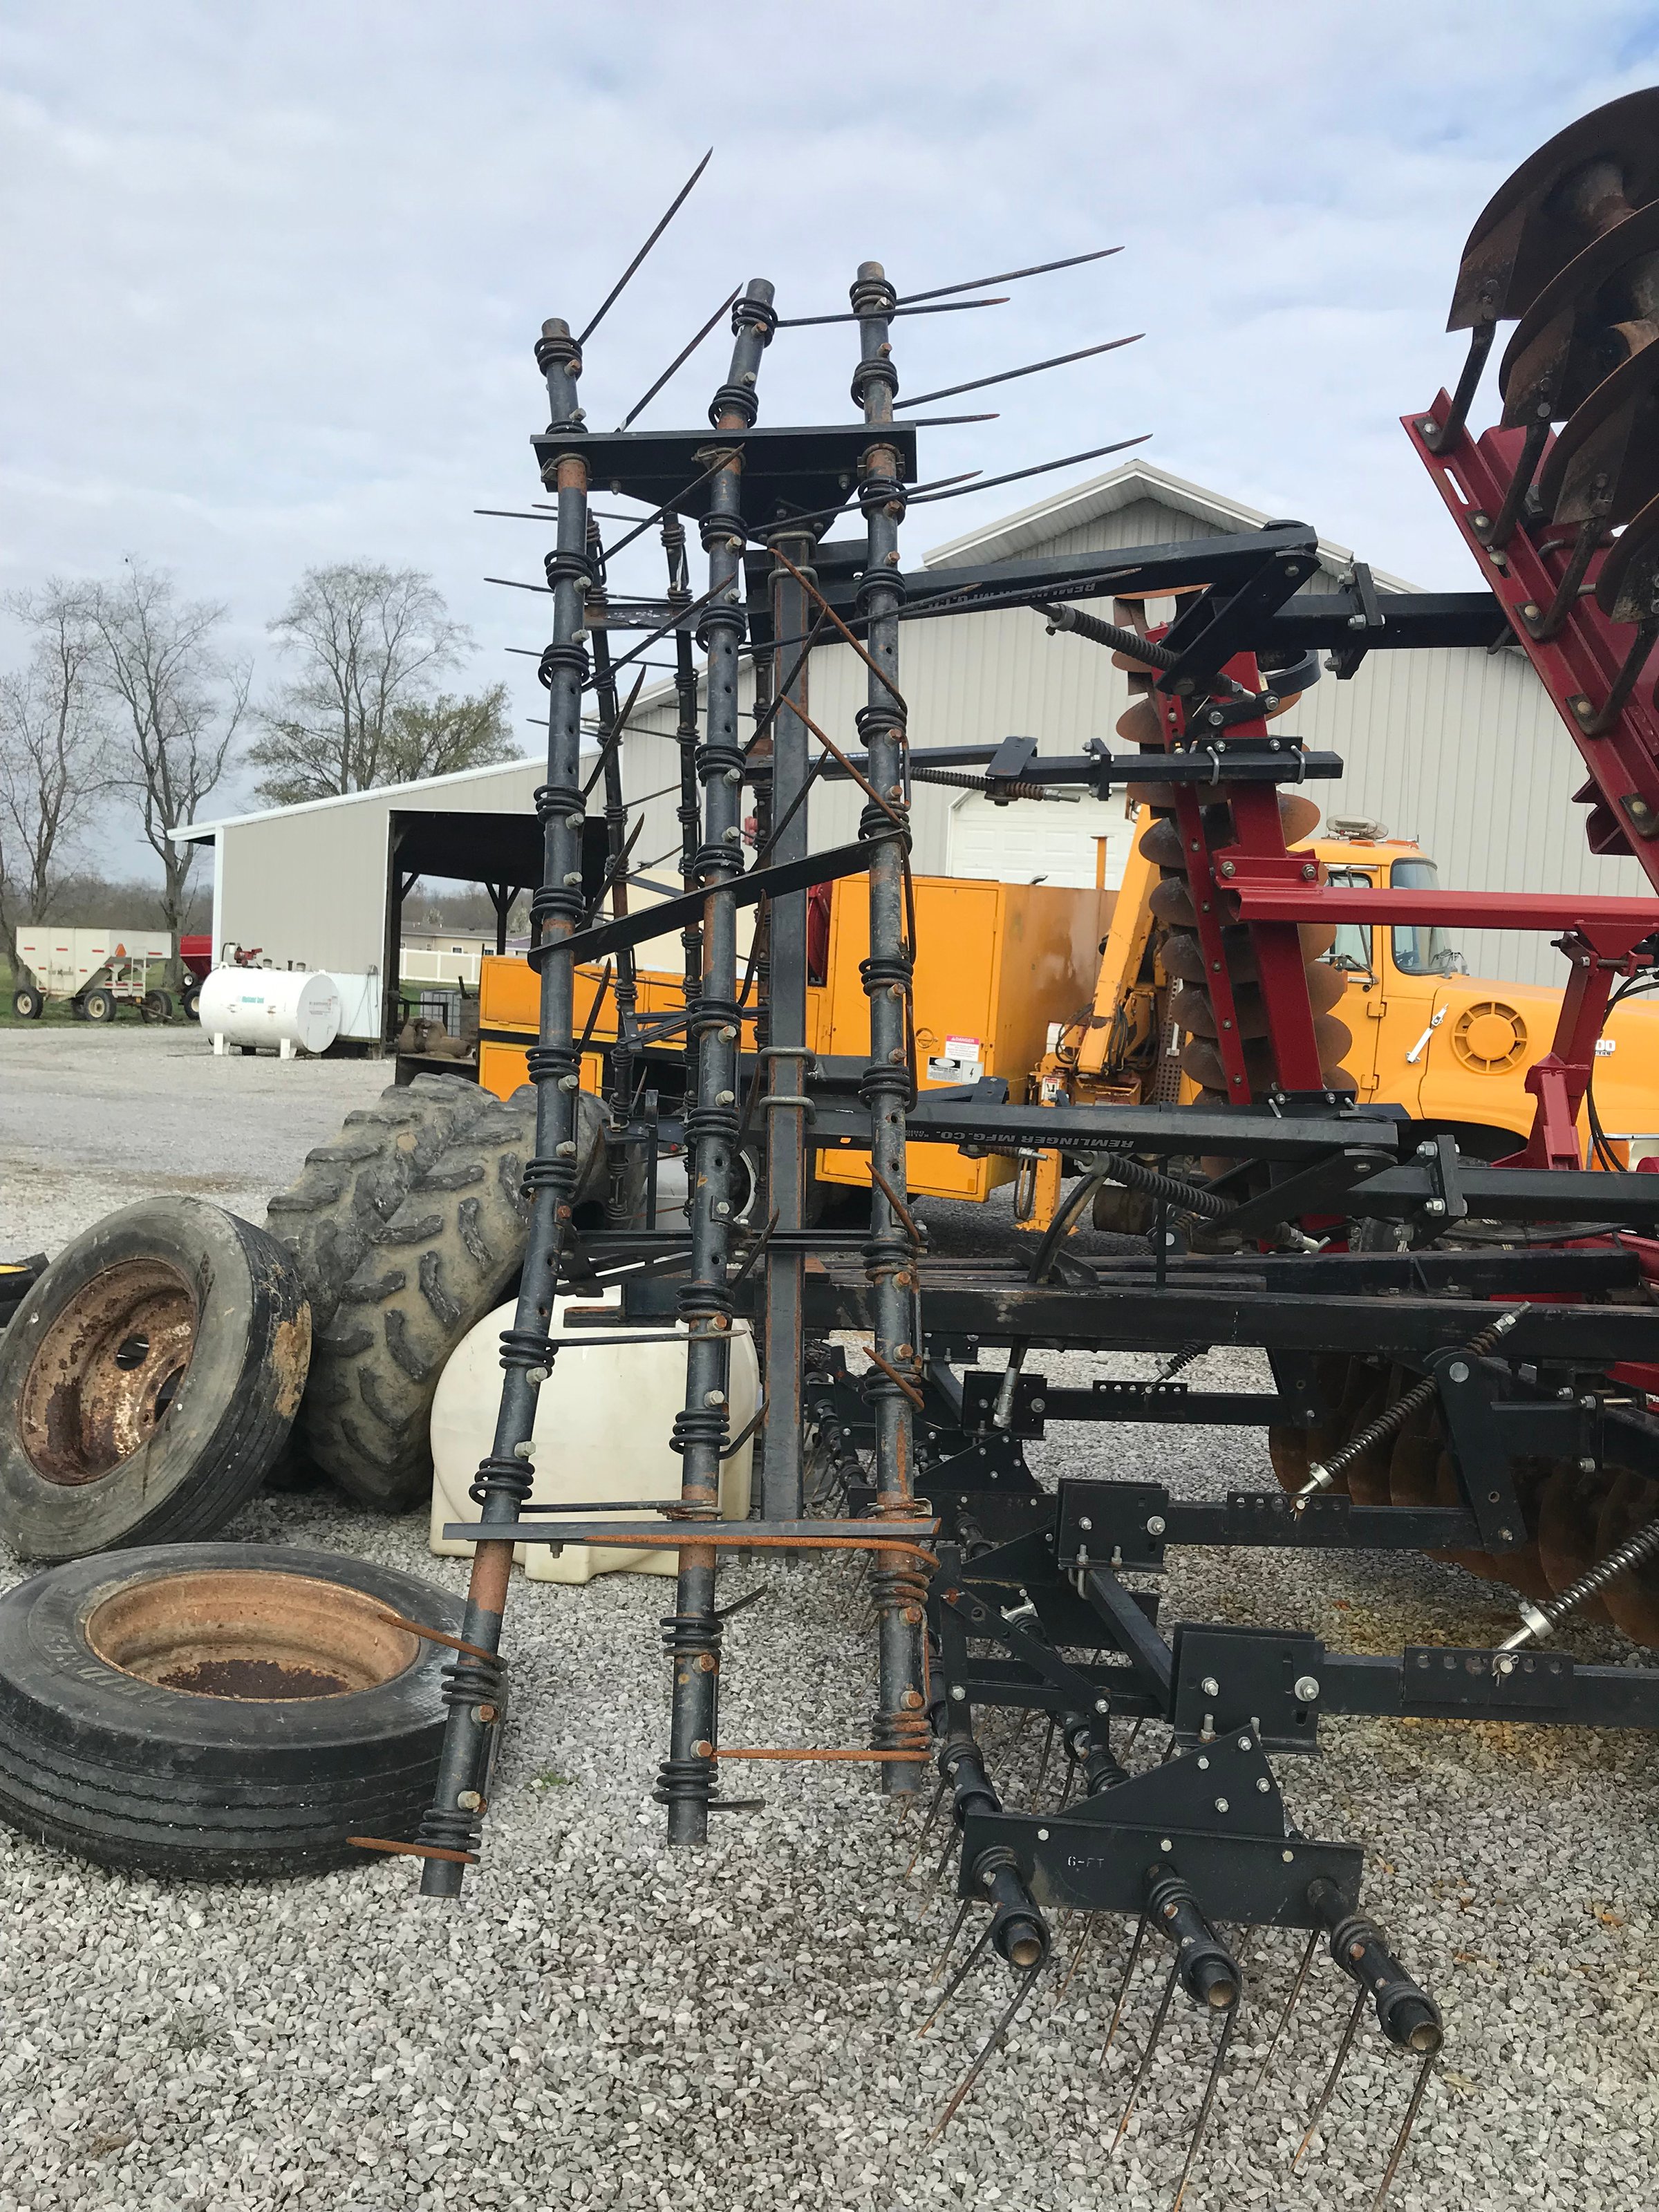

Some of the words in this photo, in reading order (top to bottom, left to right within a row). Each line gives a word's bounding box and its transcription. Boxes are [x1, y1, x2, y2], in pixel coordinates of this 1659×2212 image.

[936, 1131, 966, 1140] CO.
[968, 1132, 1015, 1143] MFG.
[1021, 1134, 1134, 1148] REMLINGER
